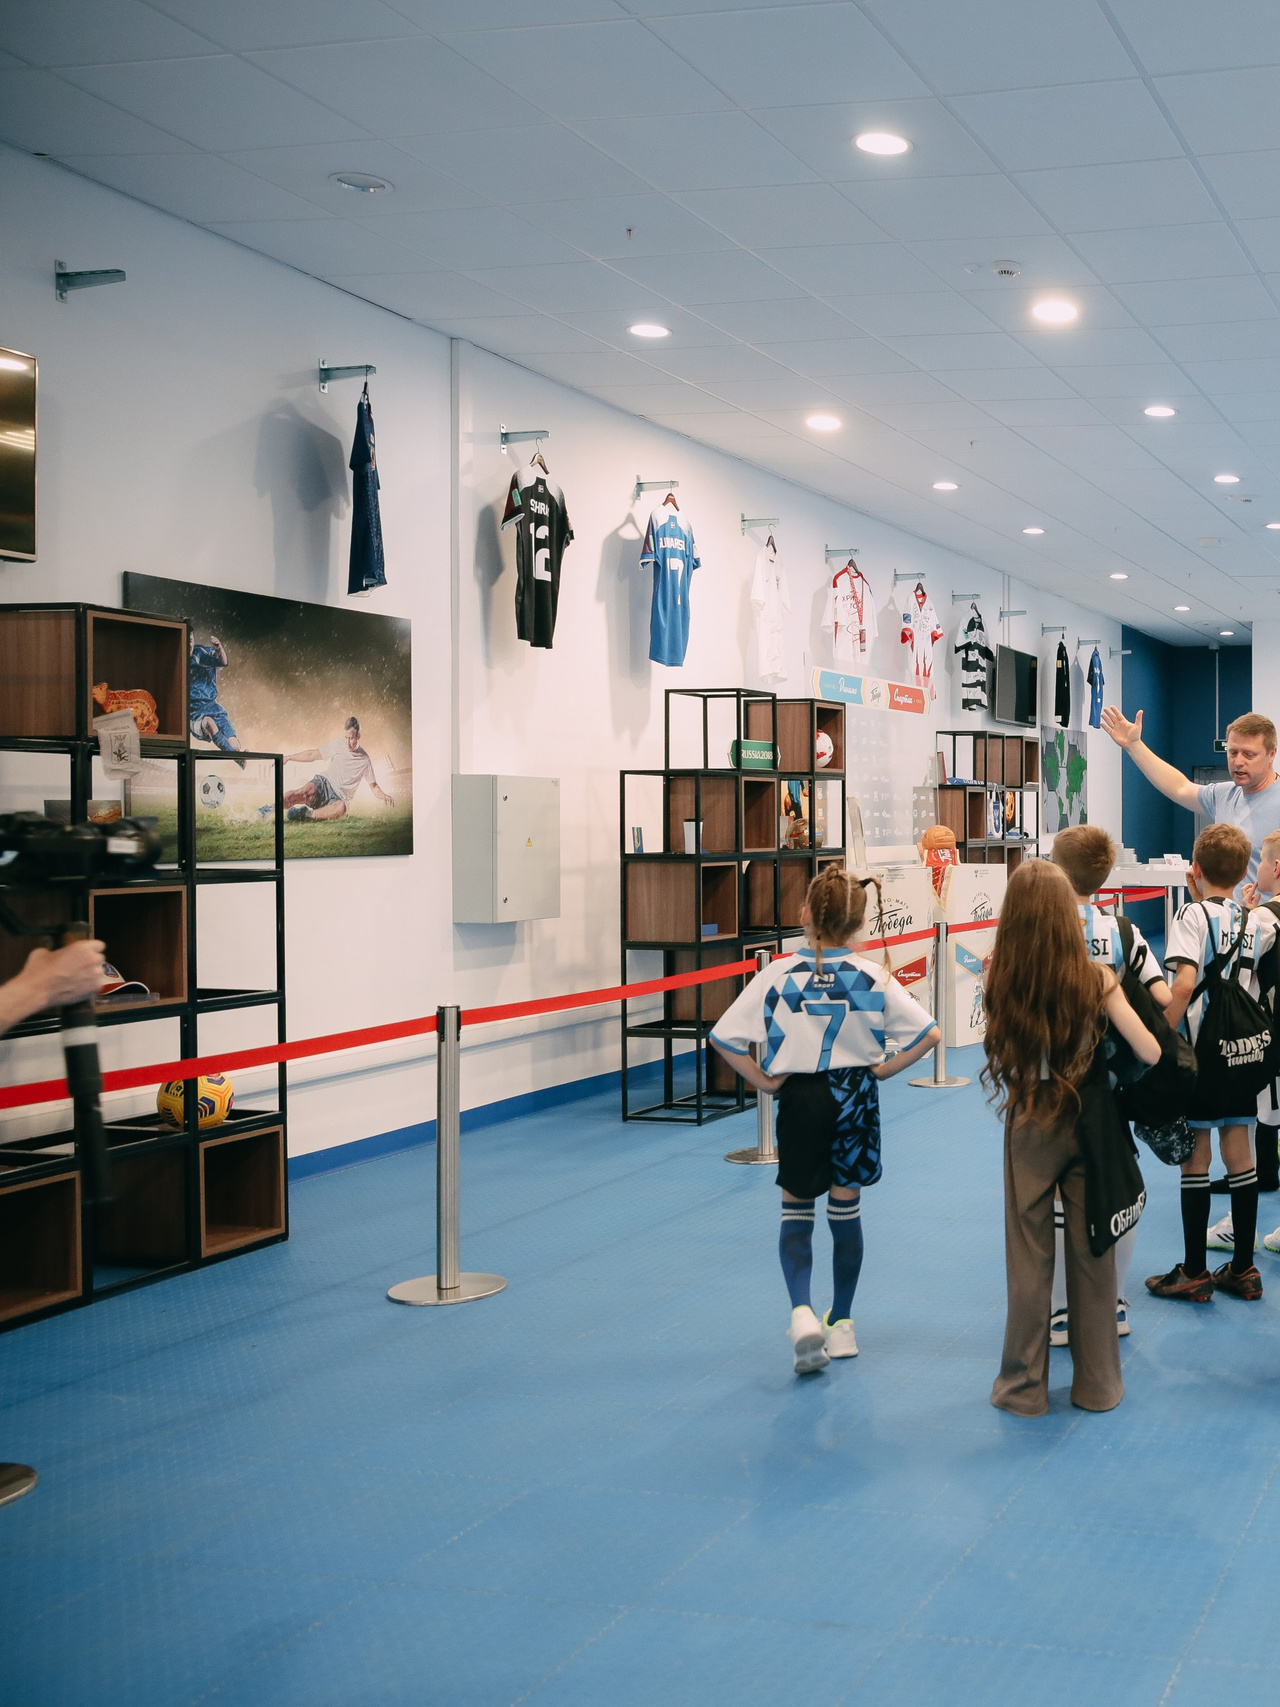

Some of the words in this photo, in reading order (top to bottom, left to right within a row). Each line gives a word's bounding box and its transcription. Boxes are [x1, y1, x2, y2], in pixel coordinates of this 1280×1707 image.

[529, 522, 552, 582] 12
[1221, 929, 1254, 950] MESI
[801, 1001, 848, 1072] 7
